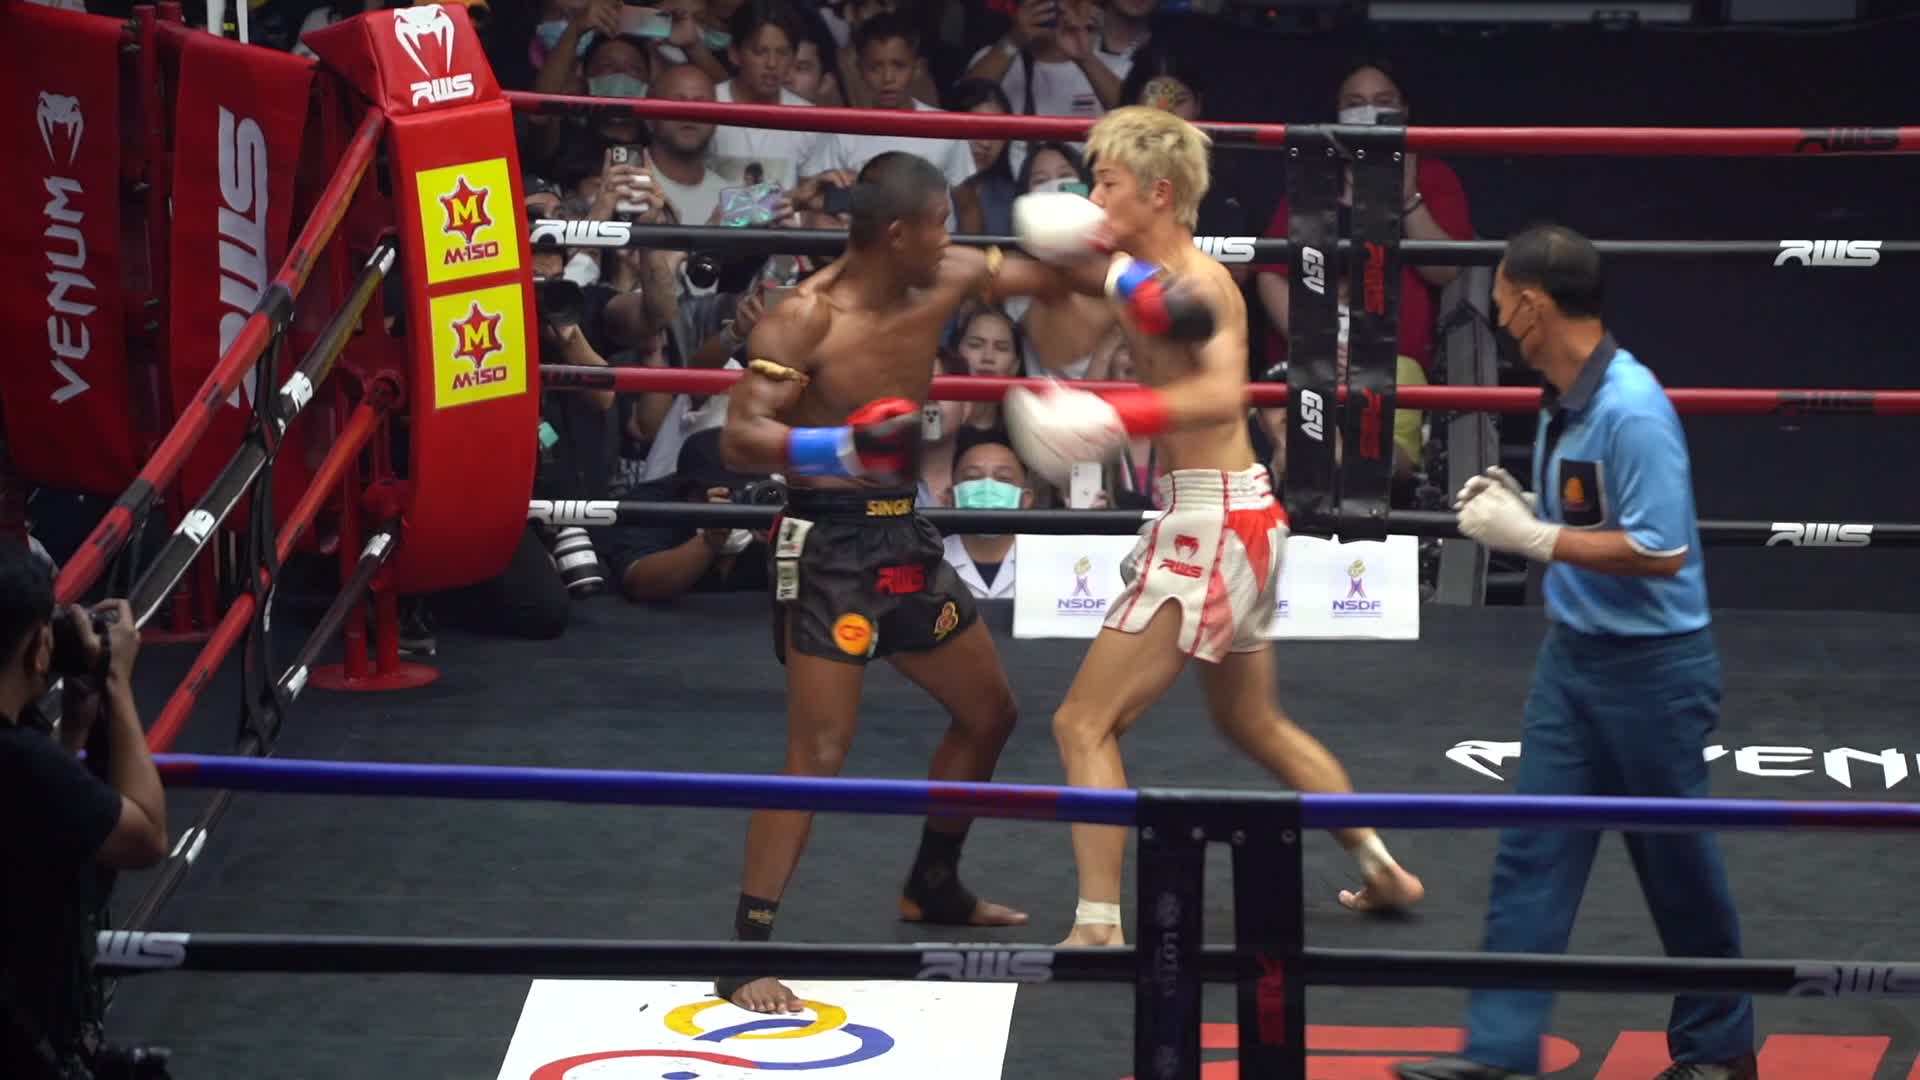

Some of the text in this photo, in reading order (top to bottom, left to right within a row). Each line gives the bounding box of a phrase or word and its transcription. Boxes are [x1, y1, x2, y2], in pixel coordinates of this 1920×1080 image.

[410, 73, 475, 106] RWS
[451, 195, 482, 227] M
[530, 219, 632, 246] RWS
[443, 241, 499, 265] M-150
[1193, 236, 1257, 262] WS
[1774, 240, 1882, 266] RWS
[1302, 246, 1325, 294] GSV
[43, 175, 97, 404] VENUM
[463, 320, 493, 353] M
[452, 366, 507, 390] M-150
[1301, 389, 1324, 440] GSV
[528, 500, 620, 525] RWS
[1766, 522, 1873, 547] RWS
[1057, 598, 1106, 609] NSDF
[1332, 600, 1381, 610] NSDF
[1703, 745, 1920, 789] EN
[95, 930, 191, 968] WS
[914, 946, 1056, 981] RWS
